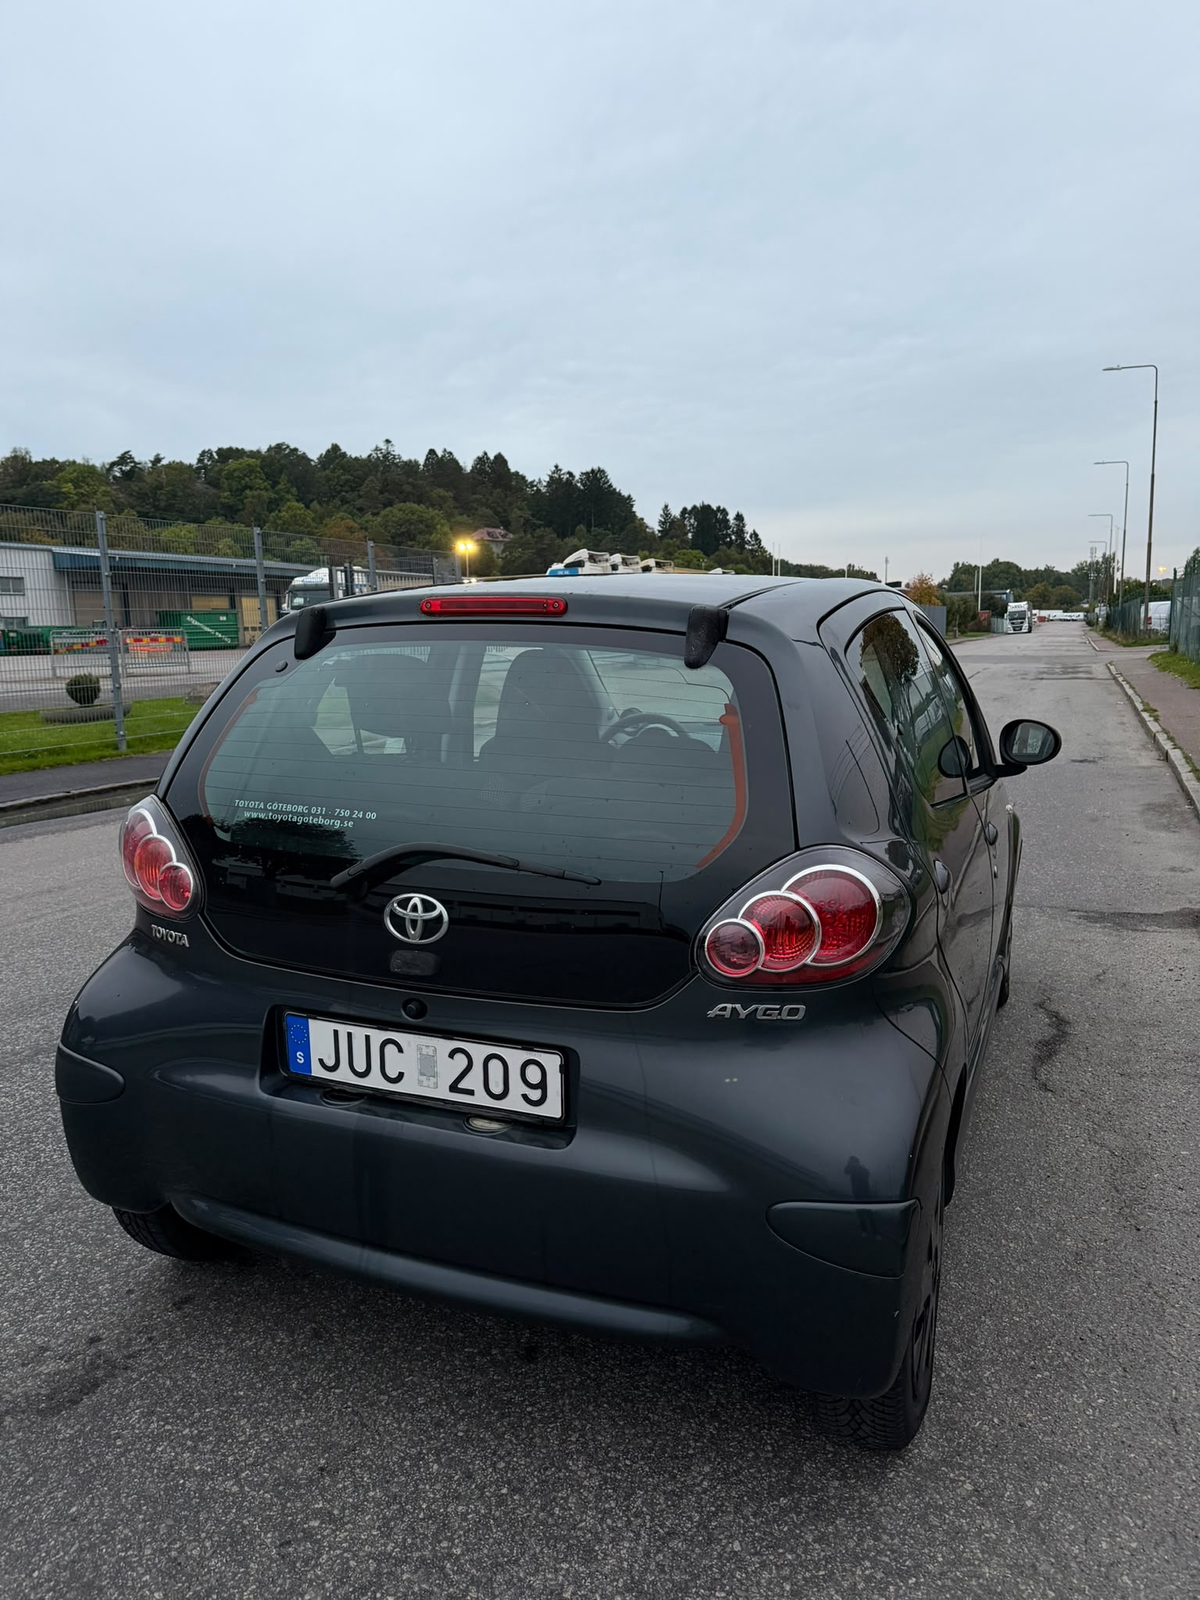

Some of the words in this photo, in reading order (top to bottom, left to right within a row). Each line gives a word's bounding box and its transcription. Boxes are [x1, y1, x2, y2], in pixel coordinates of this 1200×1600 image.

[234, 799, 264, 809] TOYOTA
[266, 801, 309, 813] GÖTEBORG
[311, 806, 326, 815] 031
[334, 808, 351, 817] 750
[352, 810, 363, 819] 24
[365, 811, 377, 820] 00
[243, 811, 354, 829] www.toyotagoteborg.se
[151, 924, 190, 948] TOYOTA
[707, 1003, 807, 1021] AYGO
[296, 1051, 305, 1064] S
[317, 1028, 405, 1085] JUC
[447, 1046, 548, 1107] 209
